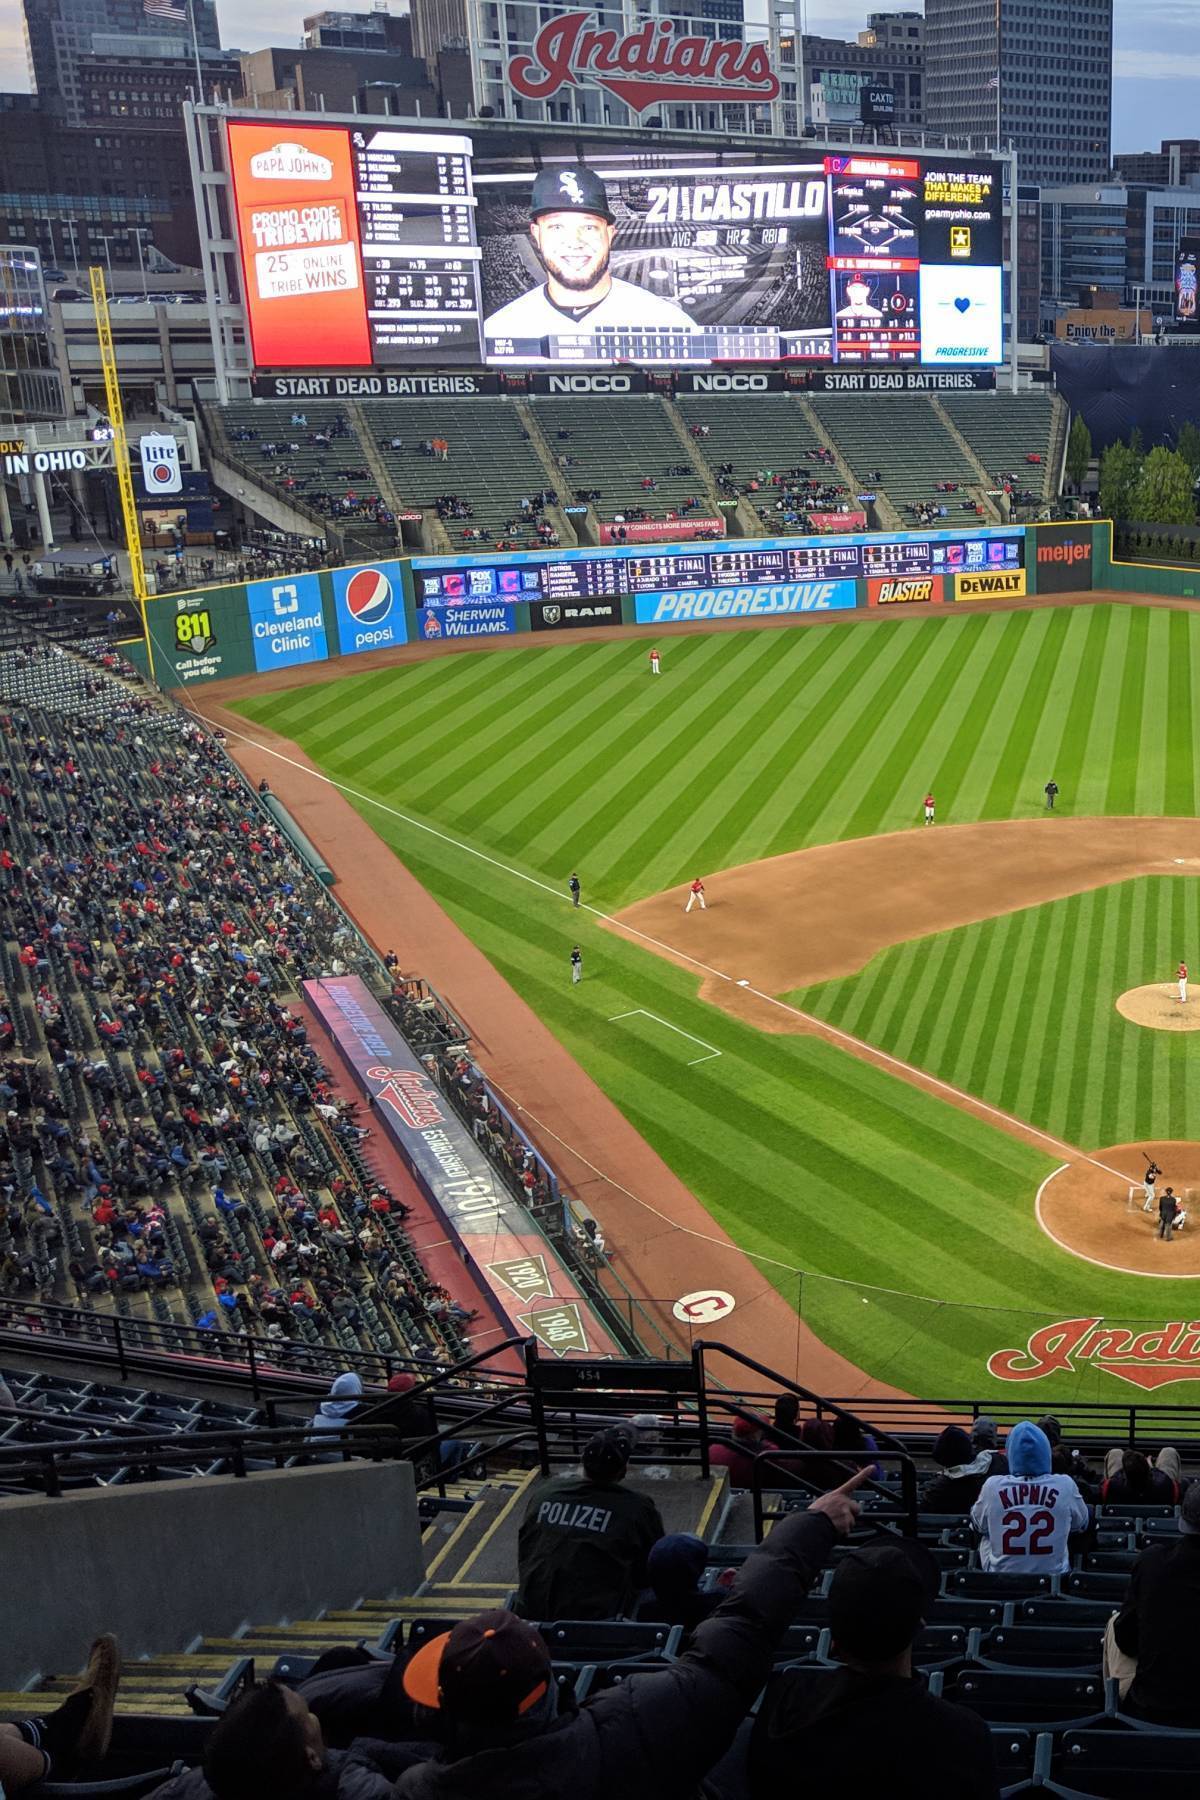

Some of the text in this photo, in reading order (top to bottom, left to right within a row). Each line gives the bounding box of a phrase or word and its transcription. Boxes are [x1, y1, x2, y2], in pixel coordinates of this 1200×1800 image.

[508, 12, 779, 100] Indians
[258, 158, 284, 172] PAPA
[924, 172, 992, 185] JOIN THE TEAM
[925, 182, 990, 194] THAT MAKES A
[645, 186, 679, 223] 21
[691, 181, 826, 222] CASTILLO
[924, 191, 984, 203] DIFFERENCE.
[252, 209, 298, 229] PROMO
[924, 208, 991, 220] goarmyohio.com
[253, 218, 342, 247] TRIBEWIN
[672, 231, 691, 247] AVG
[726, 230, 740, 245] HR
[740, 229, 751, 245] 2
[762, 228, 778, 244] RBI
[267, 254, 343, 273] 25 ONLINE
[271, 269, 347, 293] TRIBE WINS
[1066, 323, 1115, 338] Enjoy the
[935, 346, 989, 357] PROGRESSIVE
[275, 377, 480, 395] START DEAD BATTERIES.
[549, 375, 631, 392] NOCO
[693, 374, 768, 391] NOCO
[824, 374, 976, 389] START DEAD BATTERIES.
[5, 451, 86, 475] IN OHIO
[145, 446, 175, 463] Lite
[631, 520, 720, 532] CONNECTS MORE INDIANS FANS
[758, 553, 782, 566] FINAL
[833, 552, 856, 562] FINAL
[905, 546, 927, 558] FINAL
[1037, 540, 1092, 565] meijer
[678, 559, 703, 571] FINAL
[471, 571, 492, 580] FOX
[473, 584, 492, 595] GO
[960, 576, 1021, 593] DEWALT
[653, 584, 836, 620] PROGRESSIVE
[446, 608, 505, 622] SHERWIN
[565, 606, 612, 618] RAM
[176, 611, 210, 643] 811
[254, 612, 322, 639] Cleveland
[271, 634, 311, 654] Clinic
[355, 625, 394, 649] pepsi
[176, 655, 222, 671] Call before
[183, 665, 218, 680] you dig.
[367, 1066, 446, 1129] Indians
[421, 1130, 507, 1221] ESTABLISHED 1901
[505, 1261, 545, 1290] 1920
[682, 1296, 728, 1317] C
[538, 1312, 579, 1342] 1948
[578, 1370, 601, 1381] 454
[998, 1483, 1060, 1510] KIPNIS
[536, 1501, 613, 1533] POLIZEI
[1002, 1510, 1055, 1555] 22
